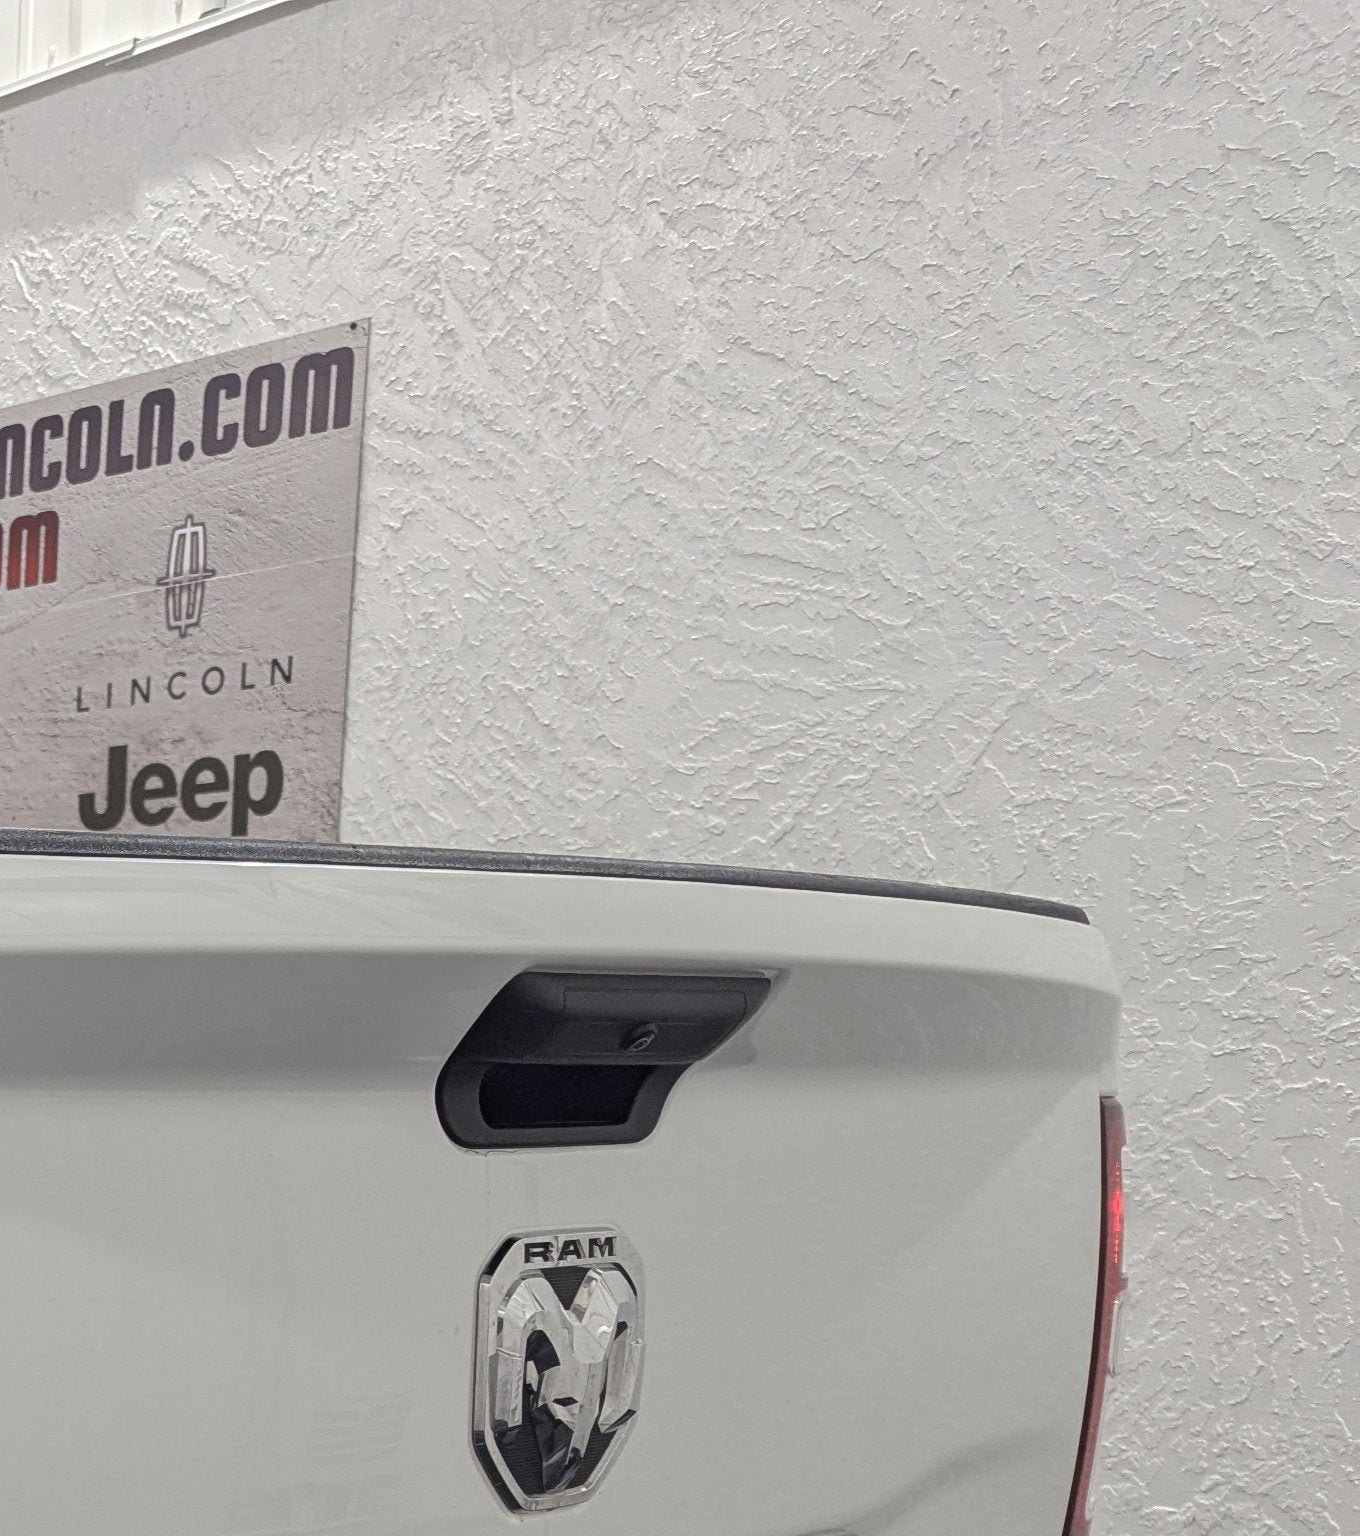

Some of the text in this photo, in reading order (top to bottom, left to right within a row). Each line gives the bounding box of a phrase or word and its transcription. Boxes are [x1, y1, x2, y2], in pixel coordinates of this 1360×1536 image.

[76, 656, 295, 713] LINCOLN
[80, 745, 283, 839] Jeep
[524, 1236, 618, 1264] RAM
